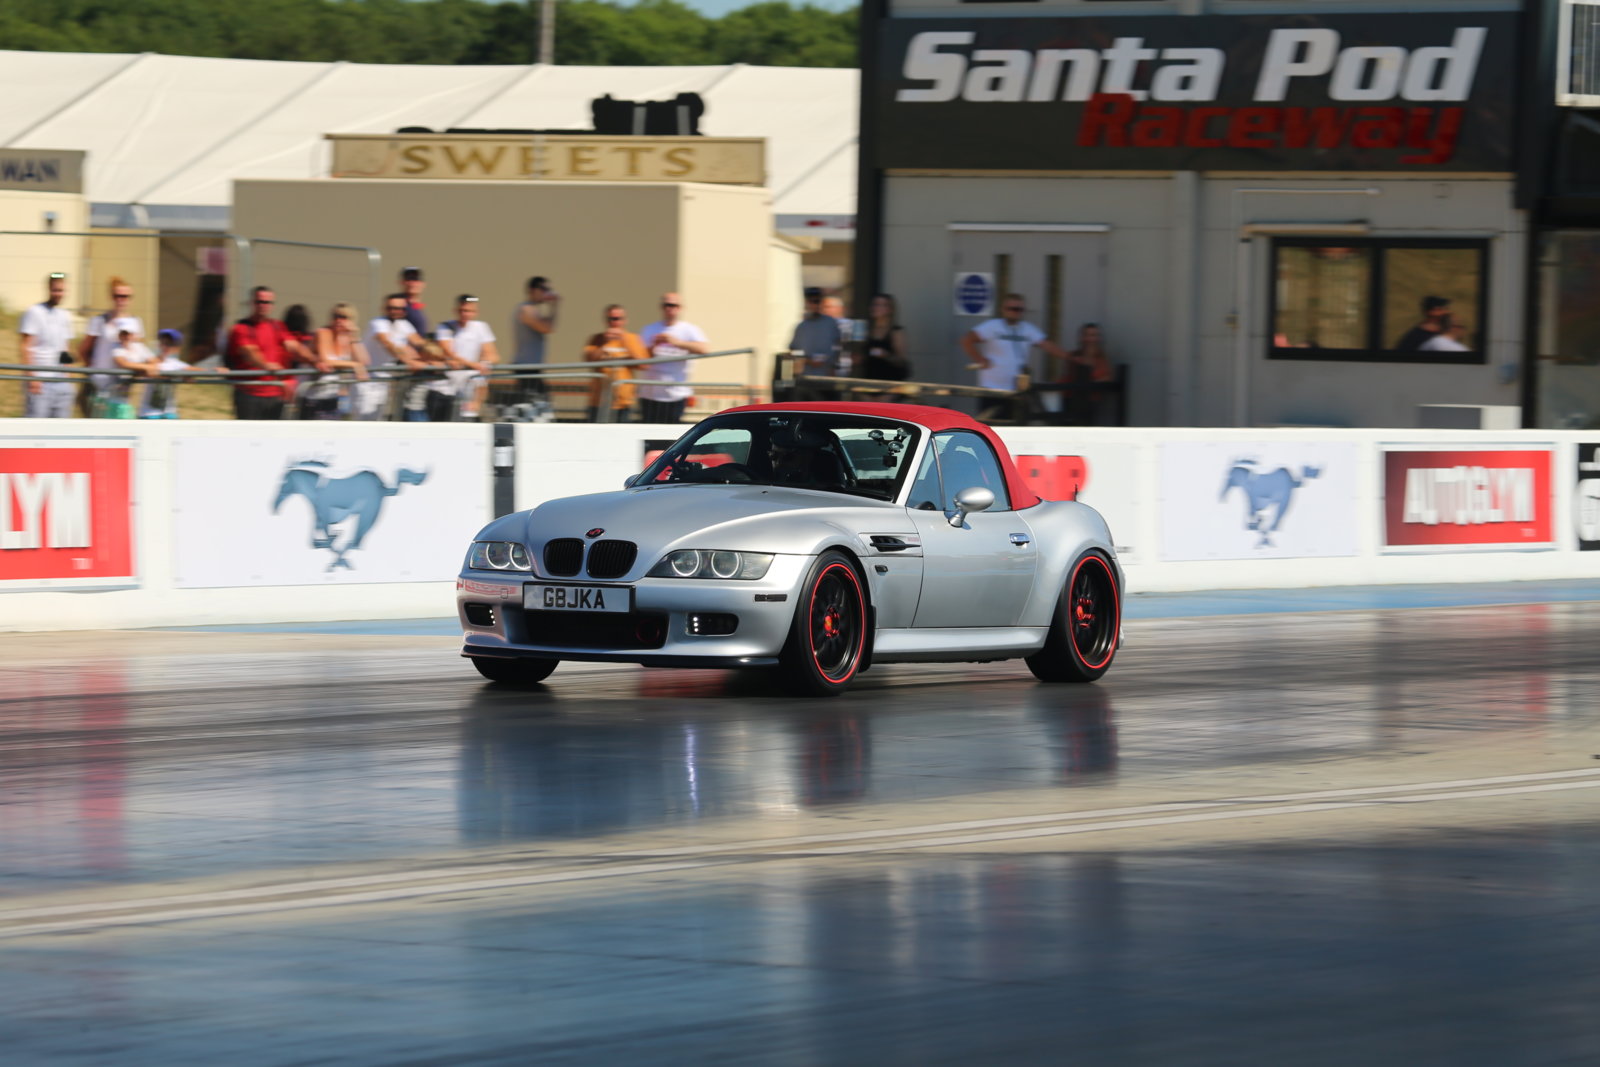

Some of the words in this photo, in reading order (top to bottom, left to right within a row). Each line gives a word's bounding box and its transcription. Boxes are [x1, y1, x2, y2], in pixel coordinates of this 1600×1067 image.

[896, 31, 1226, 102] Santa
[1252, 27, 1488, 101] Pod
[402, 145, 697, 177] SWEETS
[1077, 93, 1463, 164] Raceway
